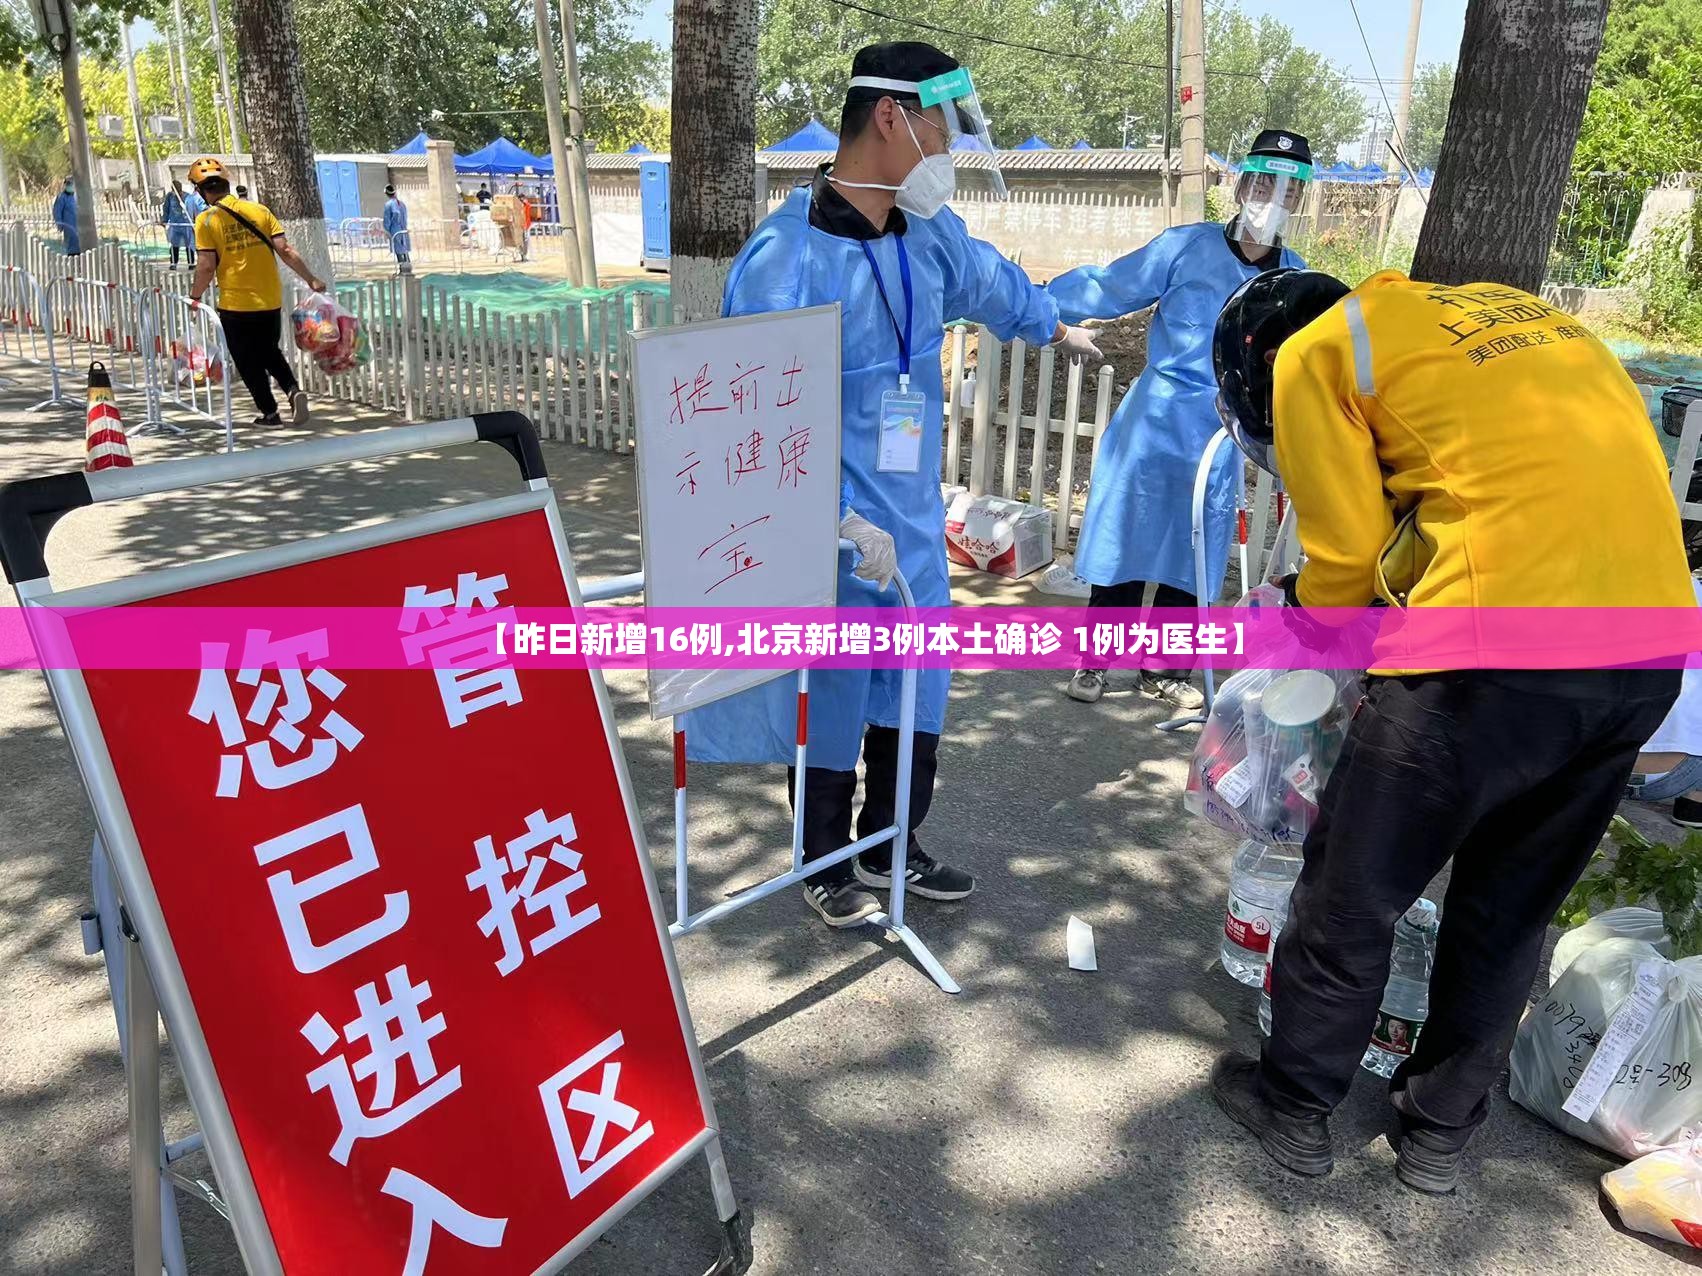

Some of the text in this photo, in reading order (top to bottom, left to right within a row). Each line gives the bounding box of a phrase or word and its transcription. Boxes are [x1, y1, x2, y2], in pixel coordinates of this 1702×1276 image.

[1466, 330, 1555, 367] 美团配送
[668, 354, 805, 424] 提前出
[675, 425, 812, 495] 示健康
[698, 513, 771, 595] 宝
[397, 571, 655, 1199] 管控区
[1255, 921, 1267, 931] 5L
